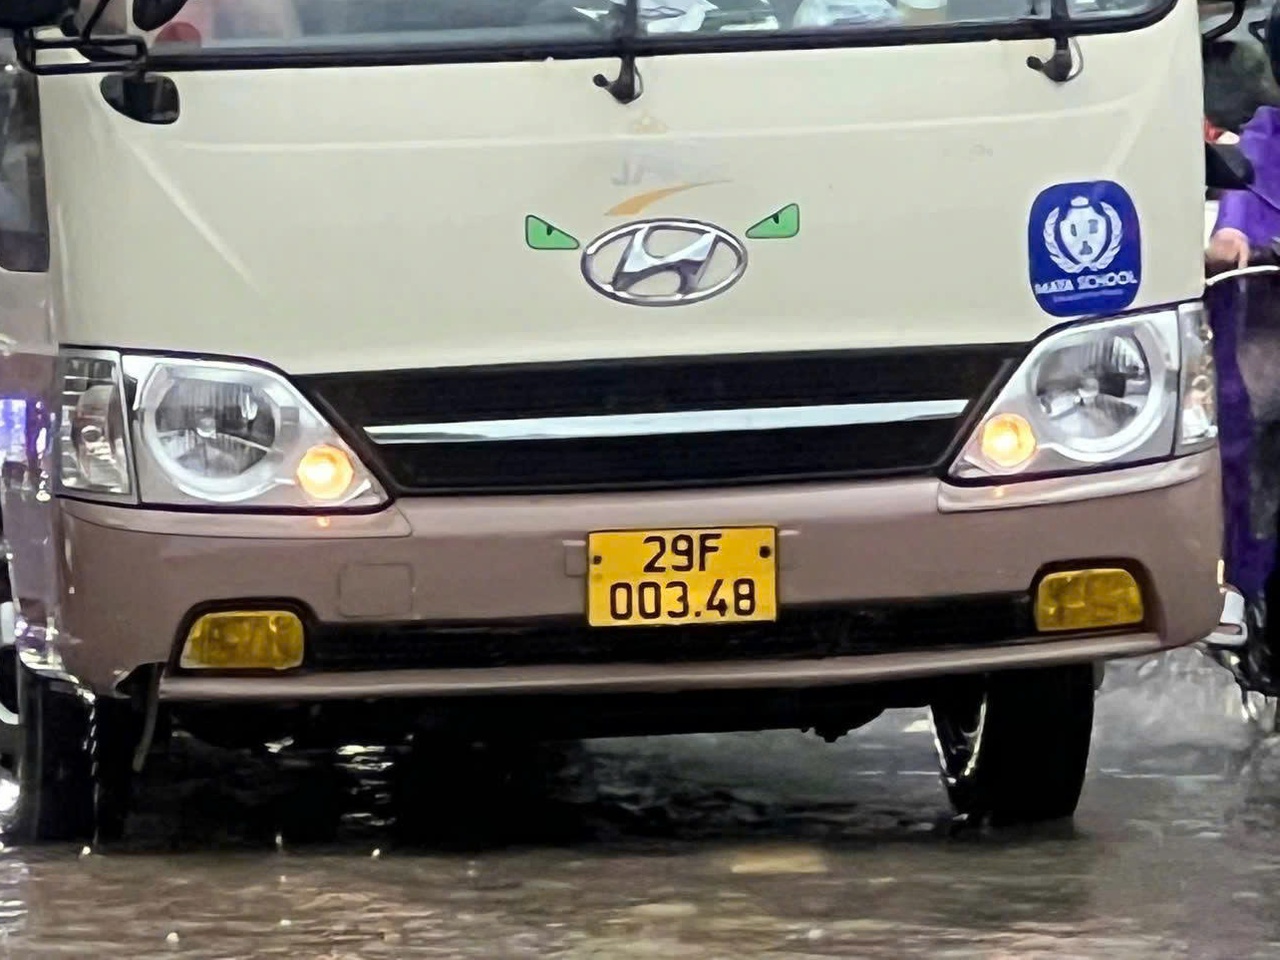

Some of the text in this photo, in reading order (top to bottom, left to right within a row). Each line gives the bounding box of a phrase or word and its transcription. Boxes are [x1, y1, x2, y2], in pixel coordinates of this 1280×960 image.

[1077, 270, 1138, 290] SCHOOL
[642, 533, 723, 573] 29F
[609, 577, 756, 621] 003.48
